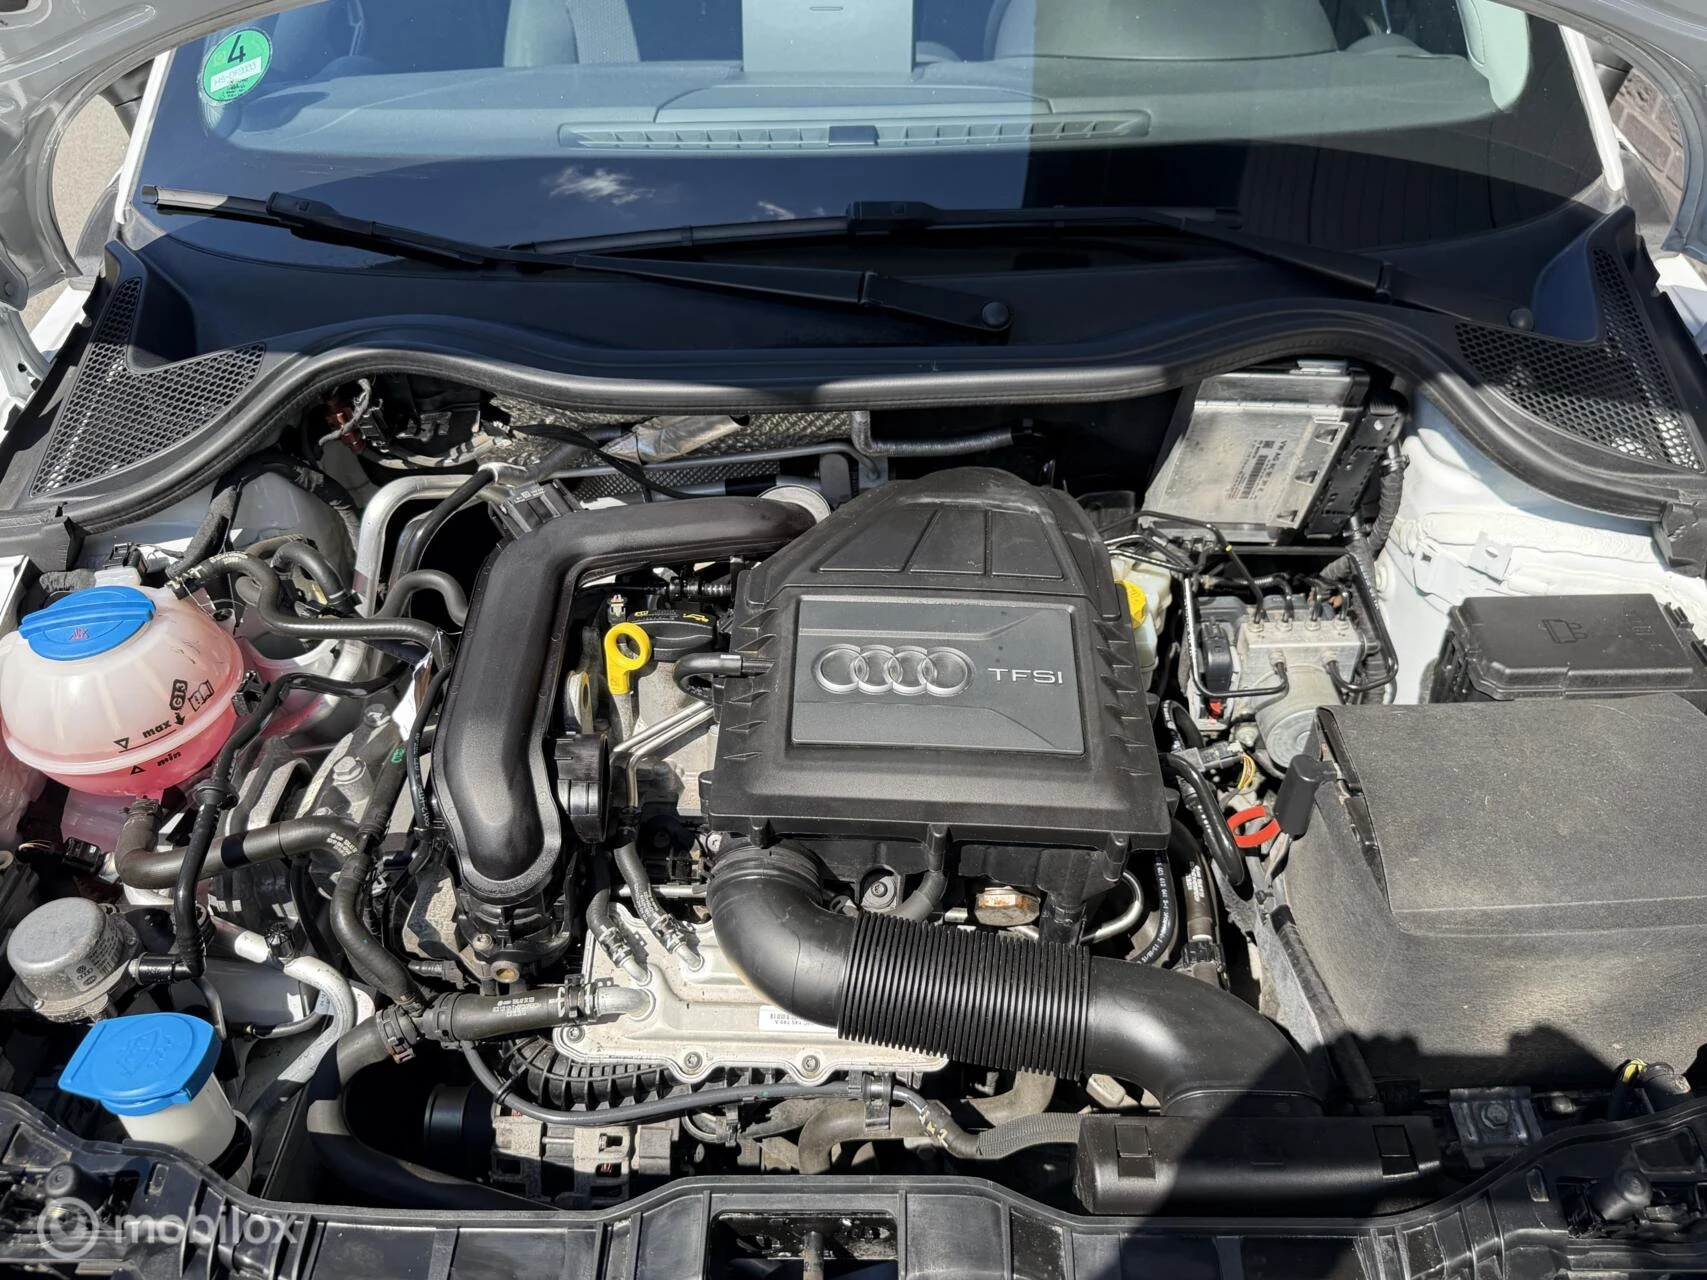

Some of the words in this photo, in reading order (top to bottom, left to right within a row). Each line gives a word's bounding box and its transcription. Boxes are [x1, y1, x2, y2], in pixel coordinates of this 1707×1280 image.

[227, 34, 246, 63] 4
[987, 667, 1063, 684] TFSI
[172, 682, 186, 708] G13
[142, 720, 172, 738] max
[157, 751, 182, 767] min
